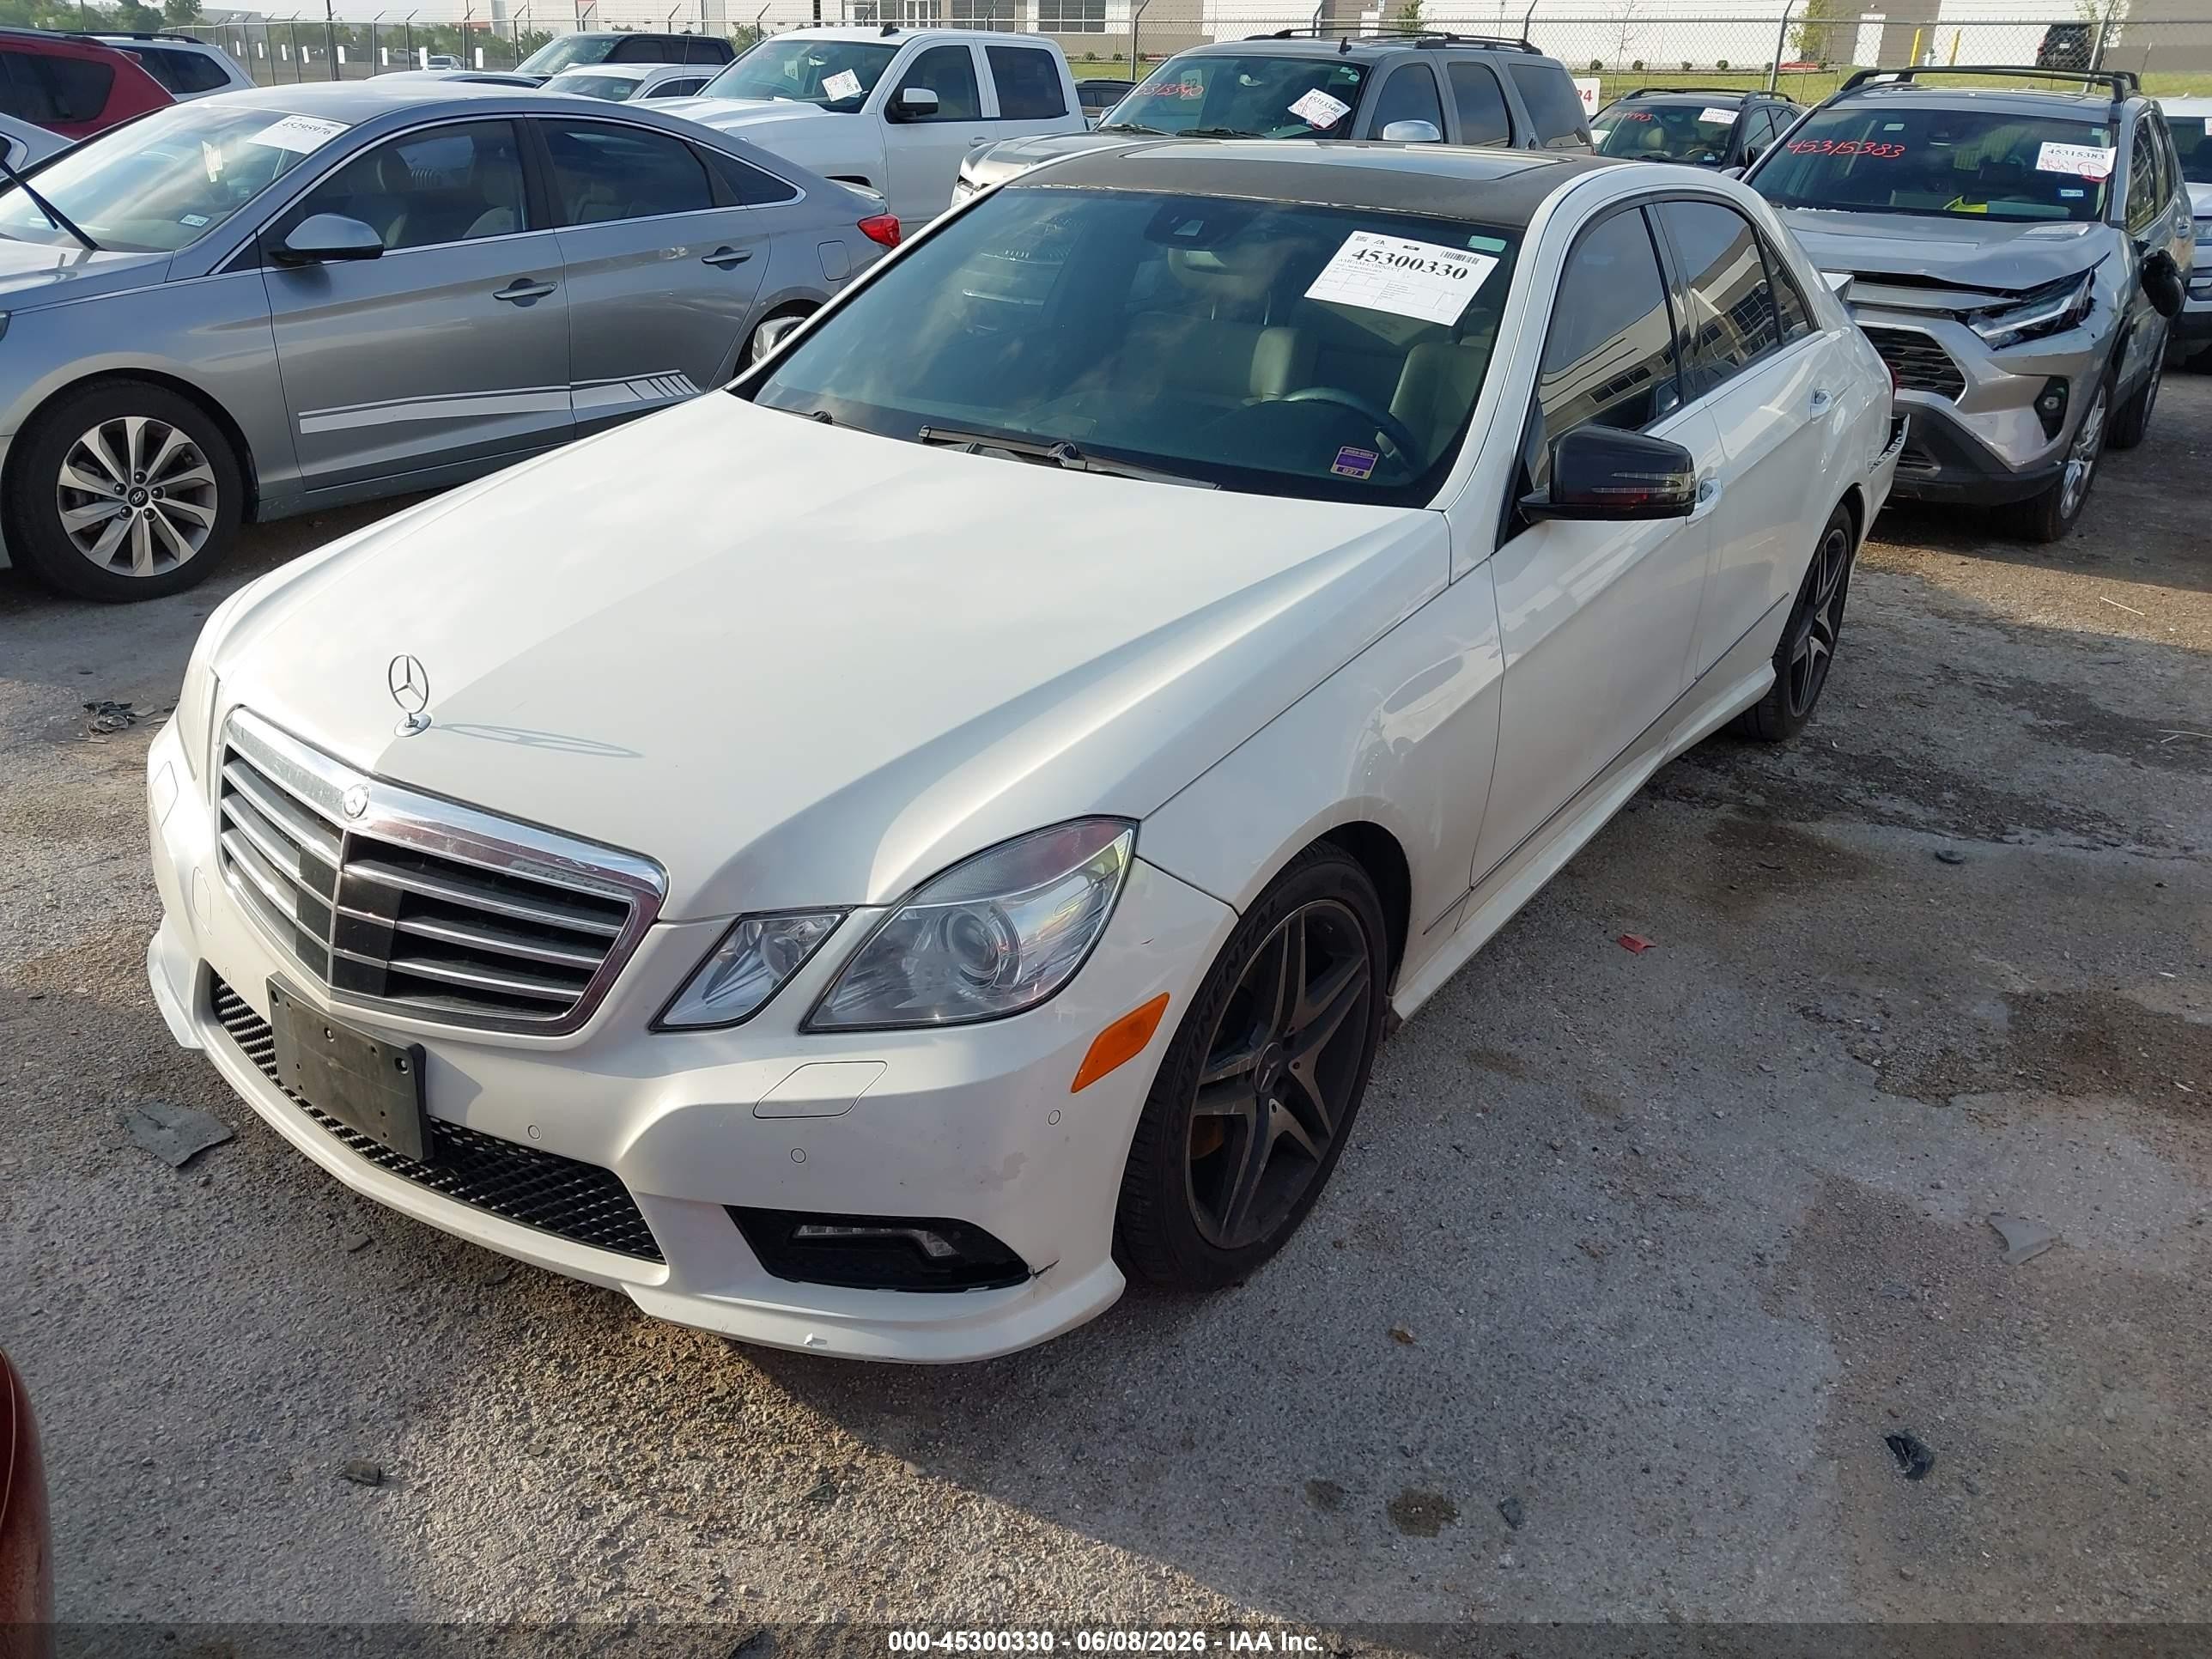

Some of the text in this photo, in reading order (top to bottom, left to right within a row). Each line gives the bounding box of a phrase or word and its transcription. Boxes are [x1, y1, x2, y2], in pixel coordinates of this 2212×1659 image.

[1787, 139, 1906, 158] 45315383
[2047, 149, 2106, 160] 45315383
[1352, 248, 1468, 281] 45300330
